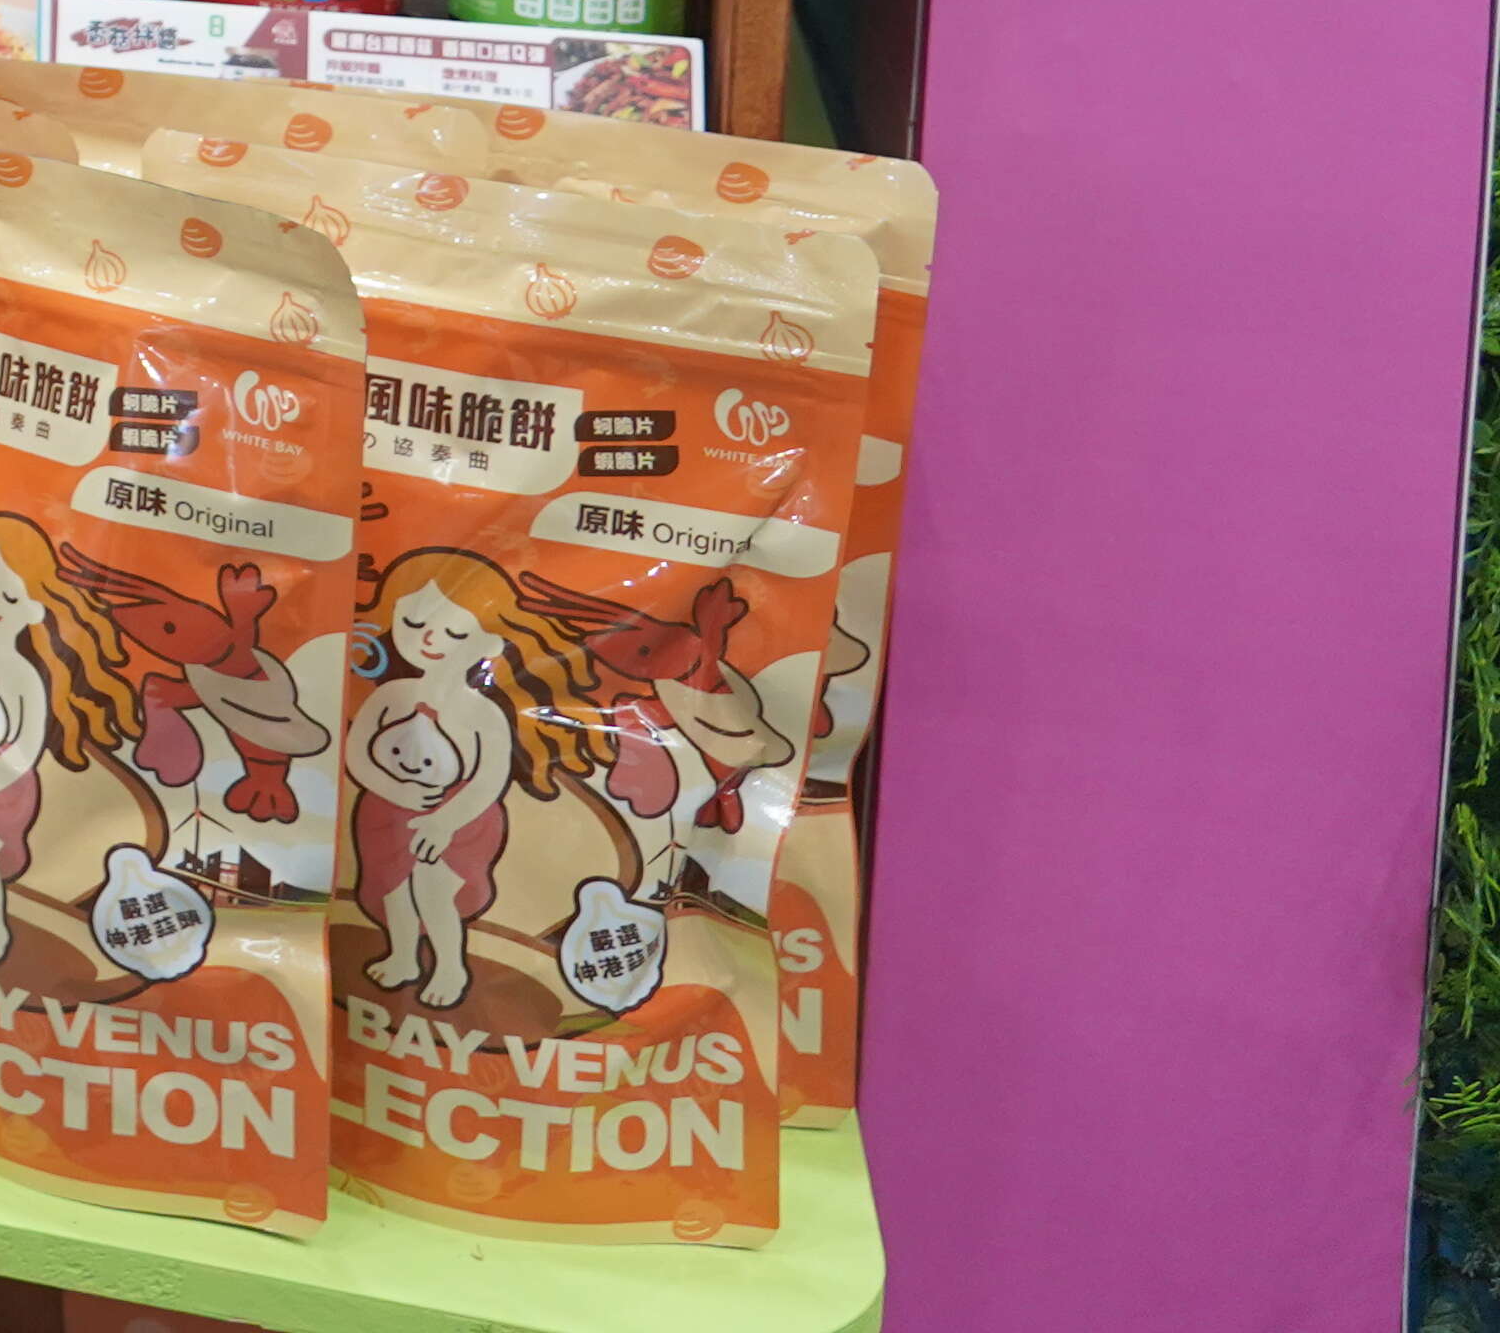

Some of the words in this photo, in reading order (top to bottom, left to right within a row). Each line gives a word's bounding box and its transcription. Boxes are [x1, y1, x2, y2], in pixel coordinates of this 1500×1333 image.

[221, 428, 272, 451] WHITE
[274, 440, 304, 457] BAY
[703, 446, 756, 465] WHITE
[104, 477, 168, 517] 原味
[173, 500, 274, 539] Original
[575, 503, 644, 541] 原味
[589, 923, 639, 950] 嚴選
[40, 995, 296, 1073] VENUS
[347, 994, 491, 1075] BAY
[503, 1031, 745, 1093] VENUS
